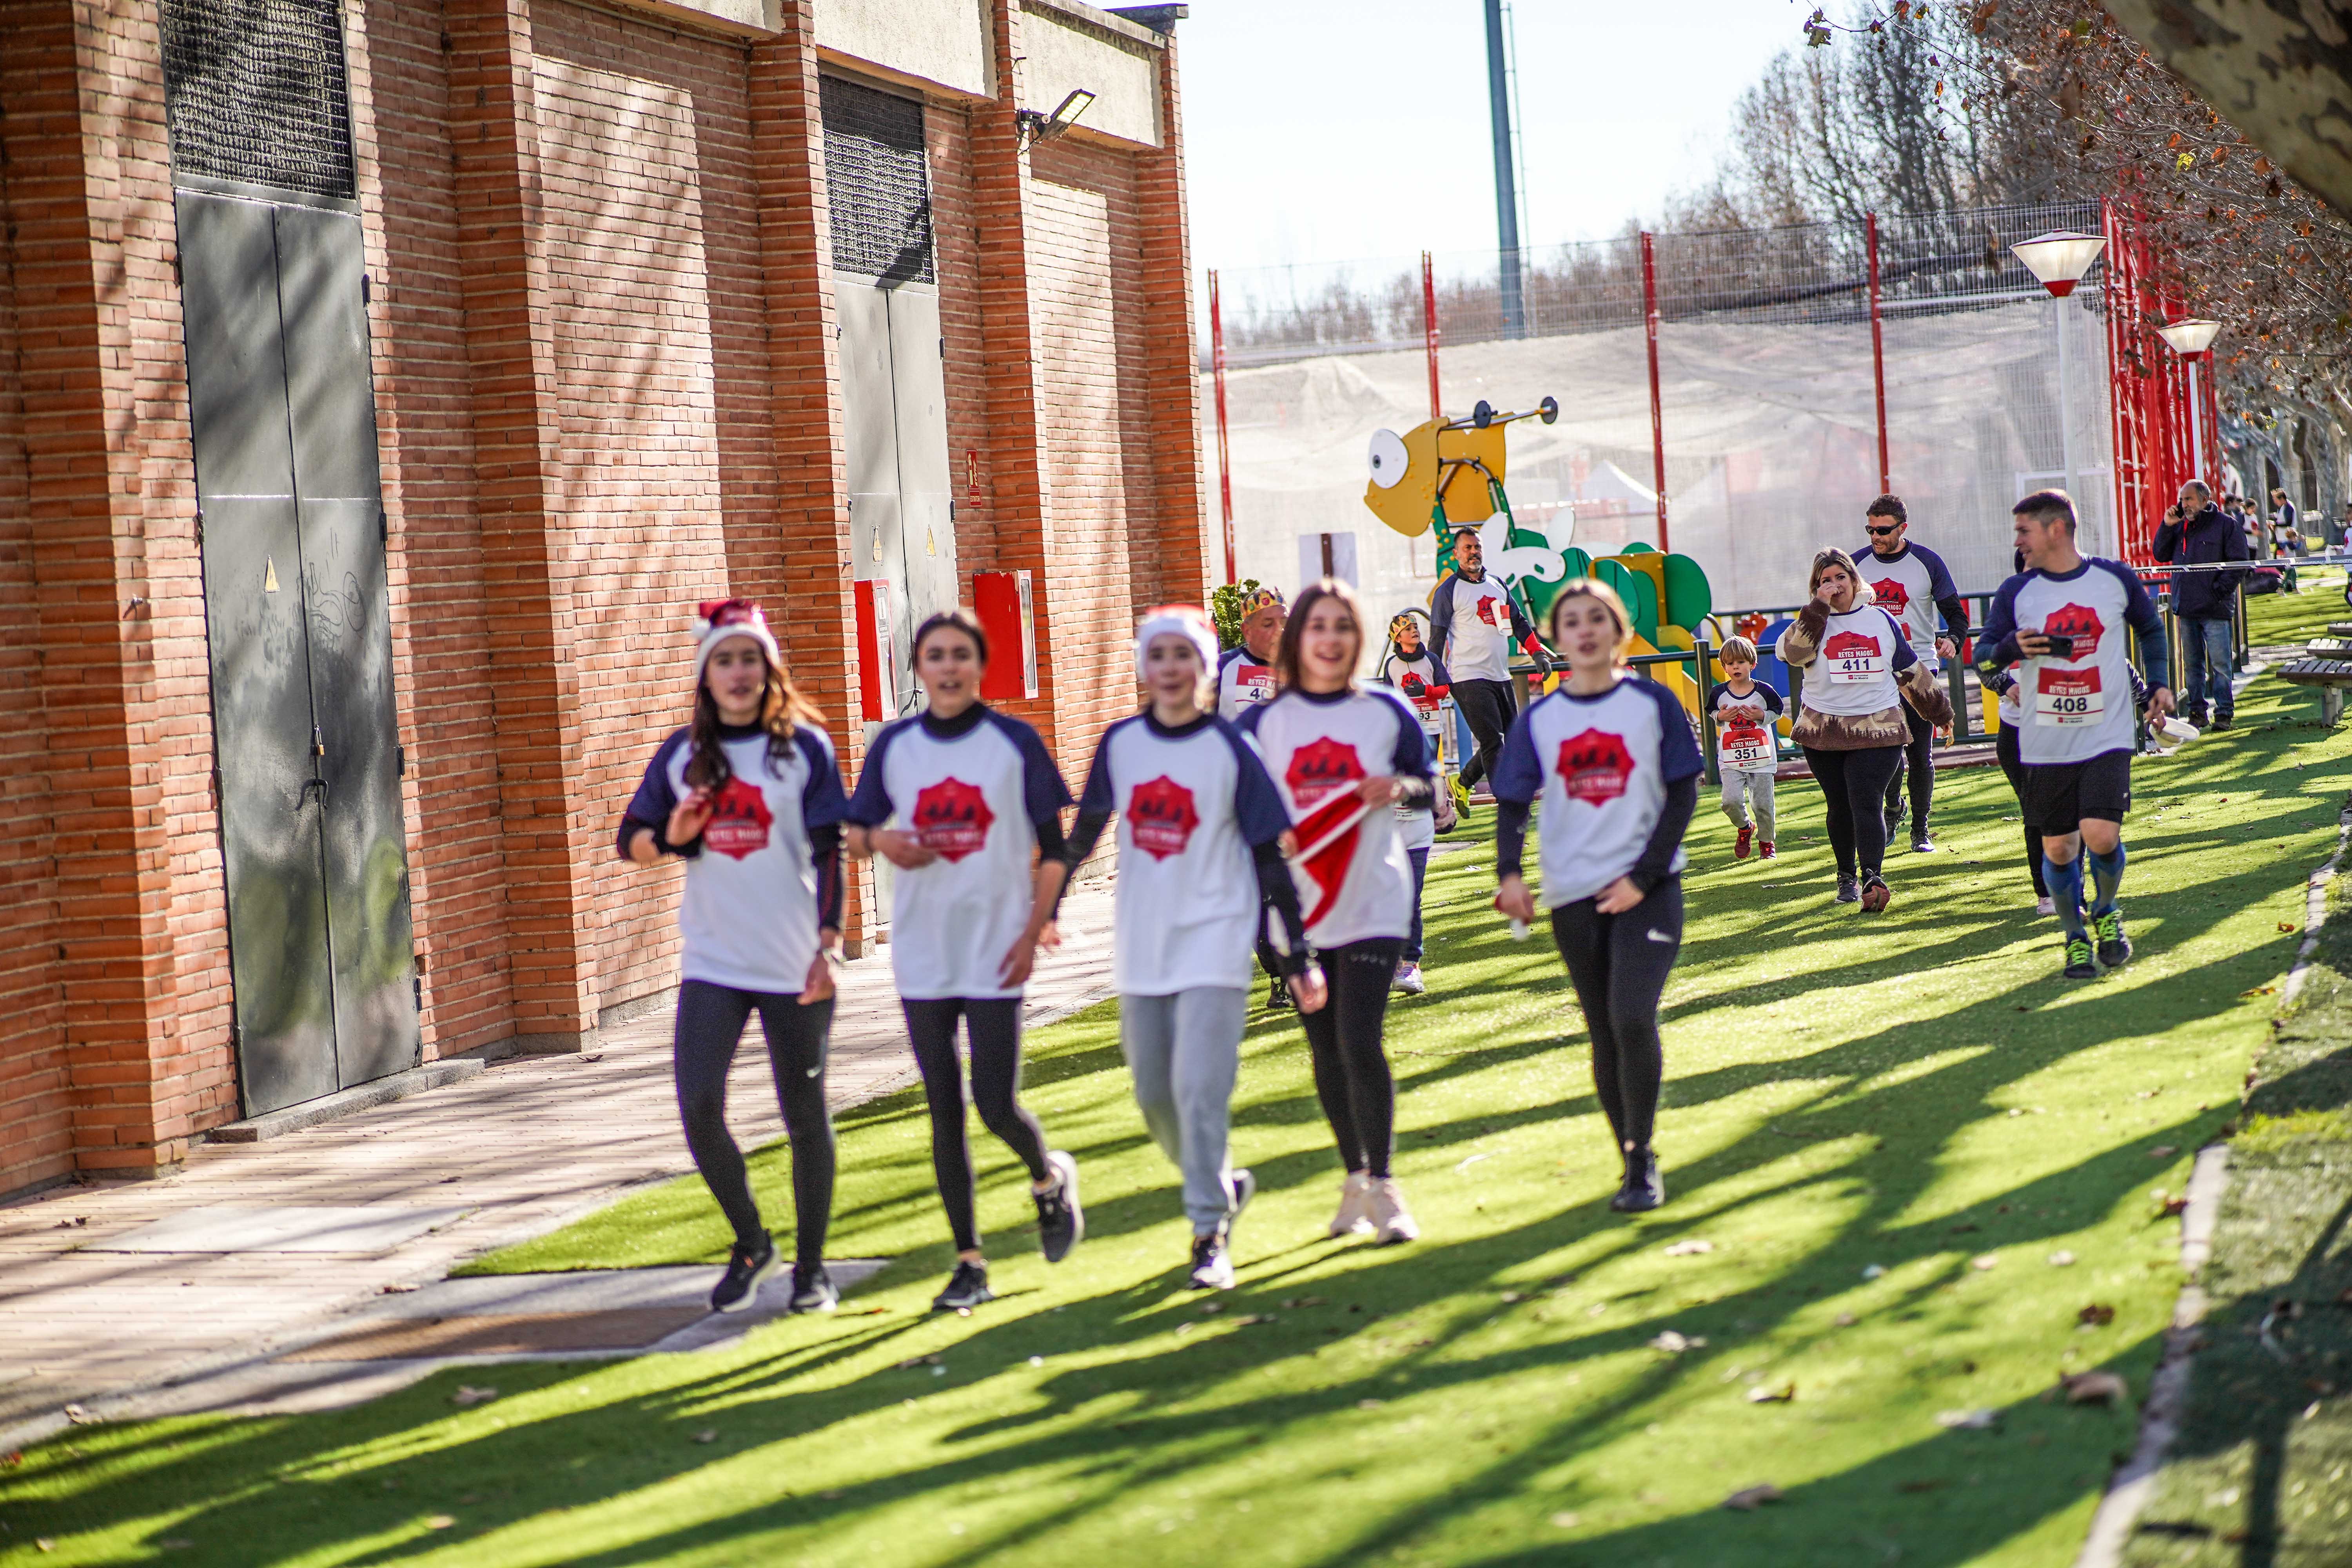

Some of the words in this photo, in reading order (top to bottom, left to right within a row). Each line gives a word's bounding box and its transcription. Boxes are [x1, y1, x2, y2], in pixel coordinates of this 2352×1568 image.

[1842, 659, 1869, 671] 411
[2053, 697, 2087, 712] 408
[1735, 748, 1757, 760] 351
